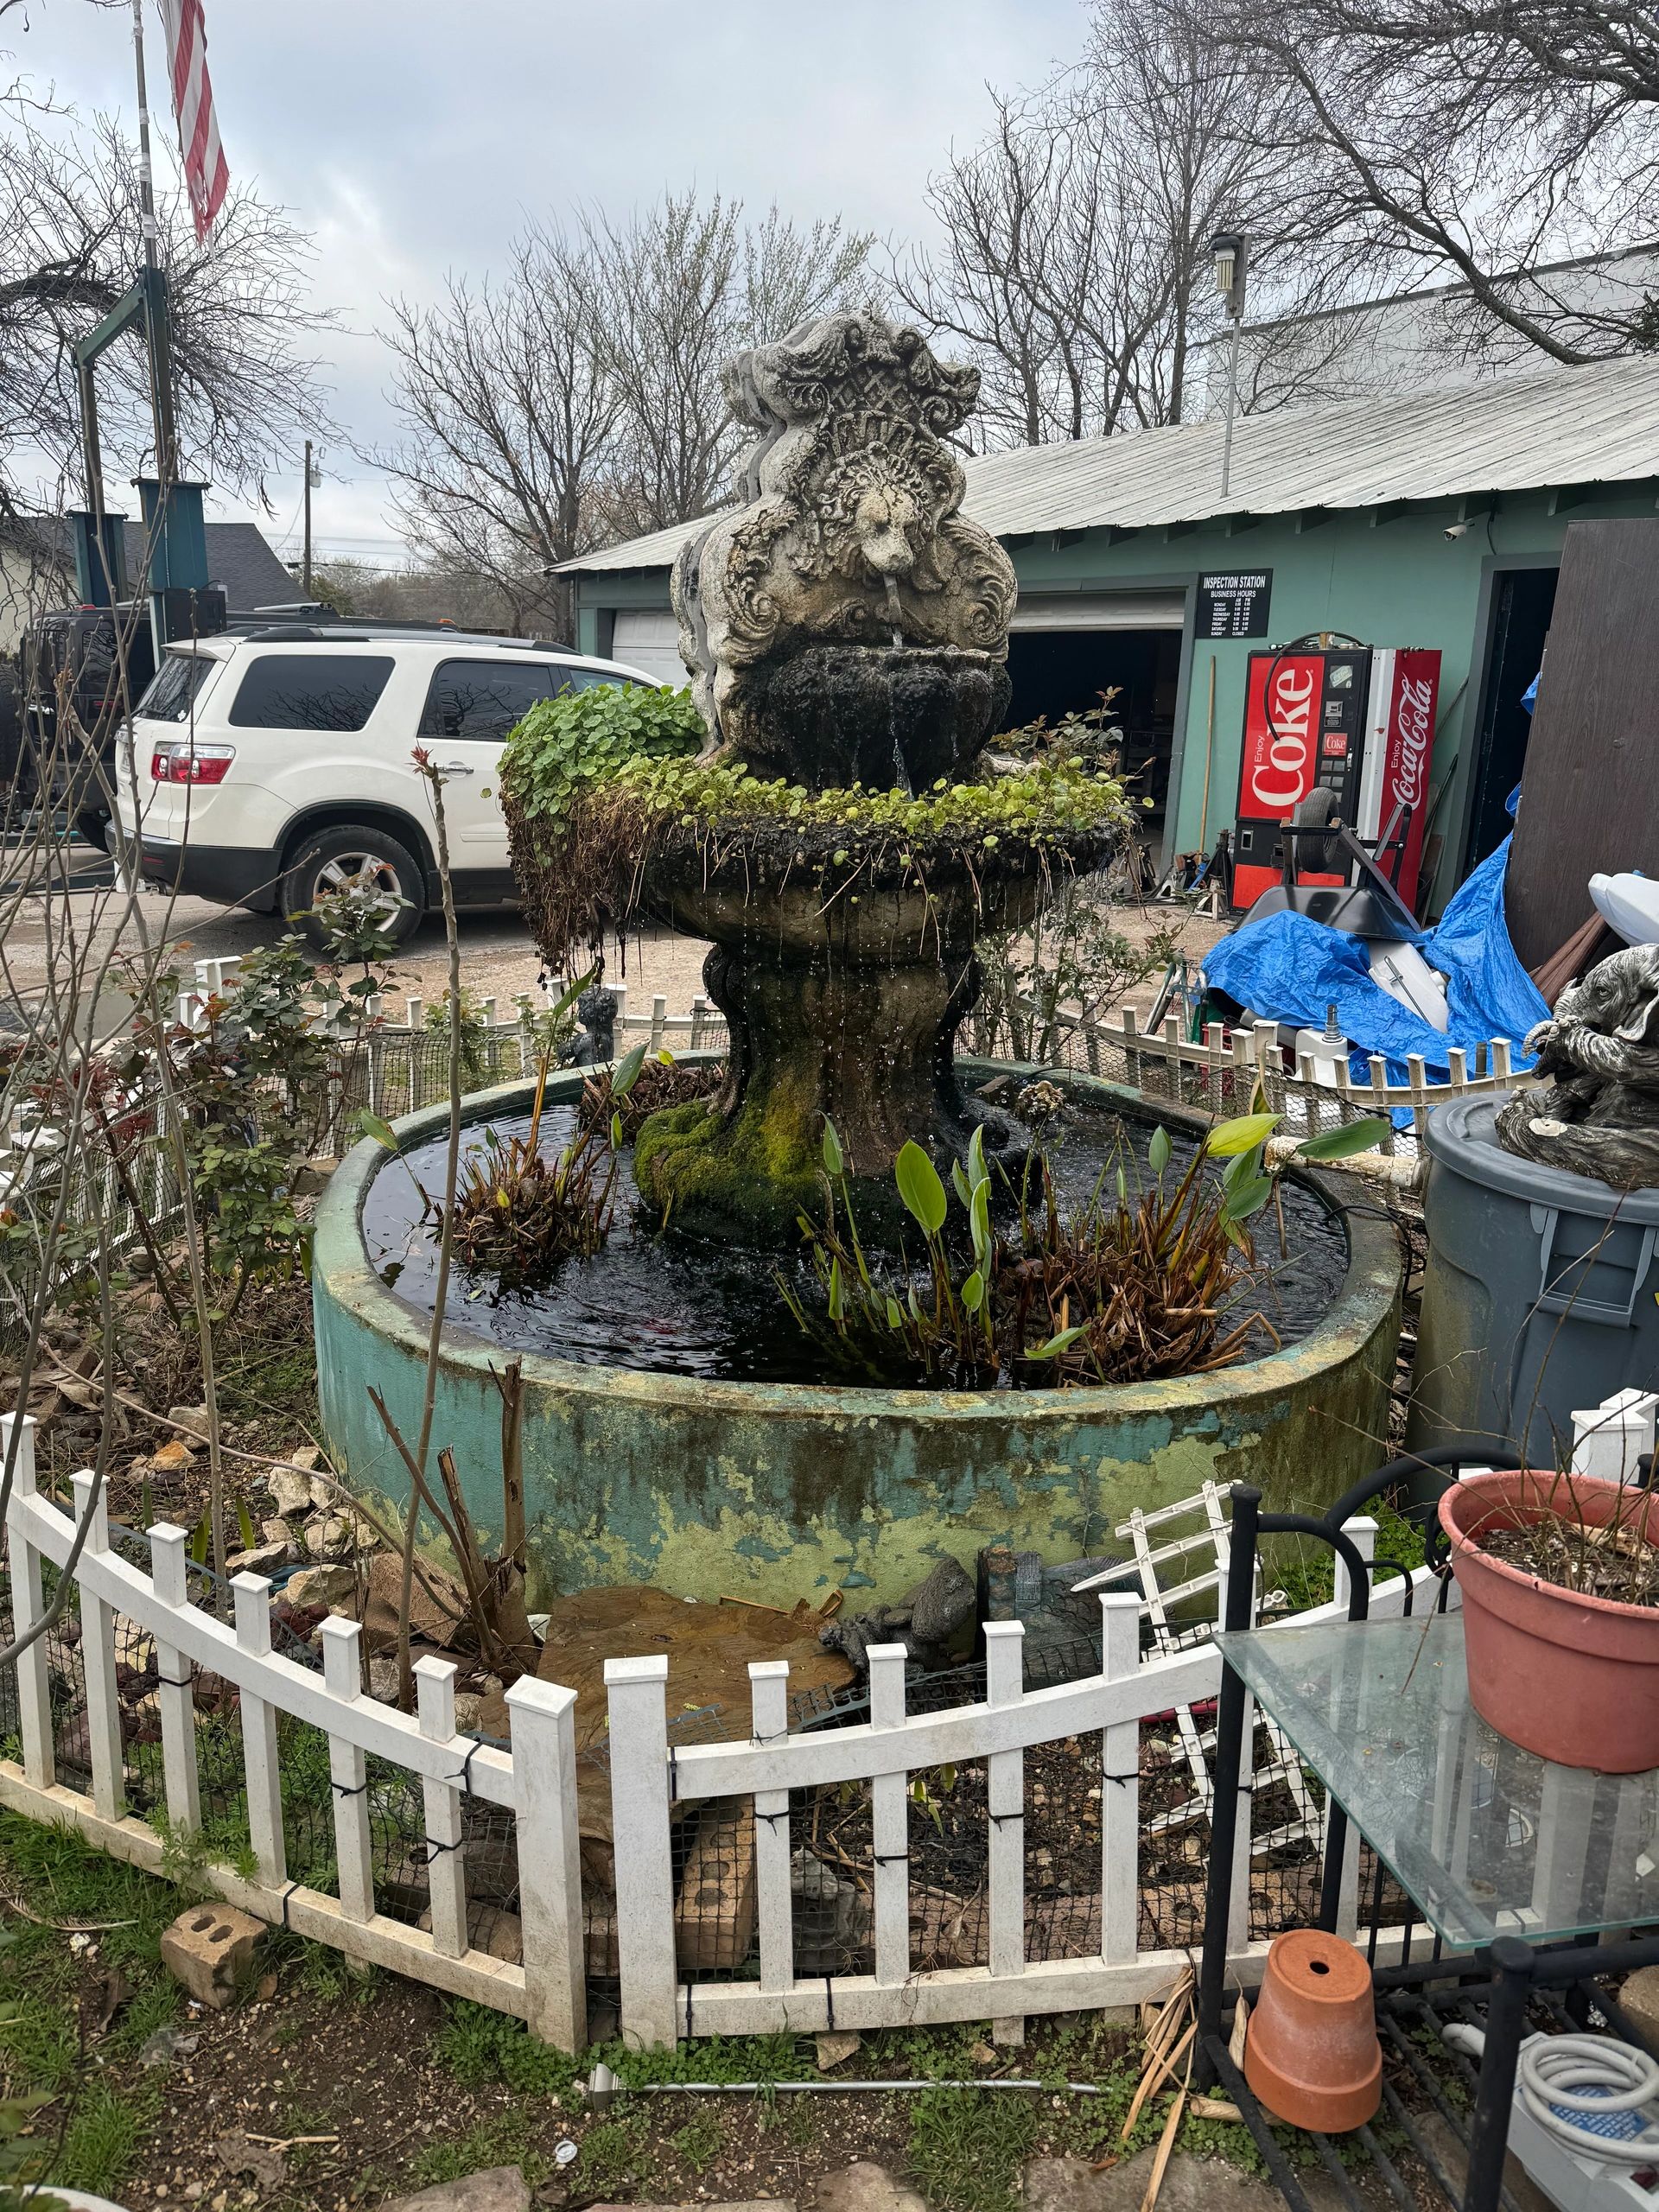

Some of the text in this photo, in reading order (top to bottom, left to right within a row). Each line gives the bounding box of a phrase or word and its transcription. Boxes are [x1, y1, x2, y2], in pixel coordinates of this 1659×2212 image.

[1204, 575, 1265, 588] INSPECTION STATION
[1252, 669, 1313, 806] Coke
[1255, 735, 1266, 762] Enjoy
[1326, 735, 1345, 749] Coke
[1392, 672, 1432, 810] Coca-Cola
[1391, 740, 1400, 768] Enjoy
